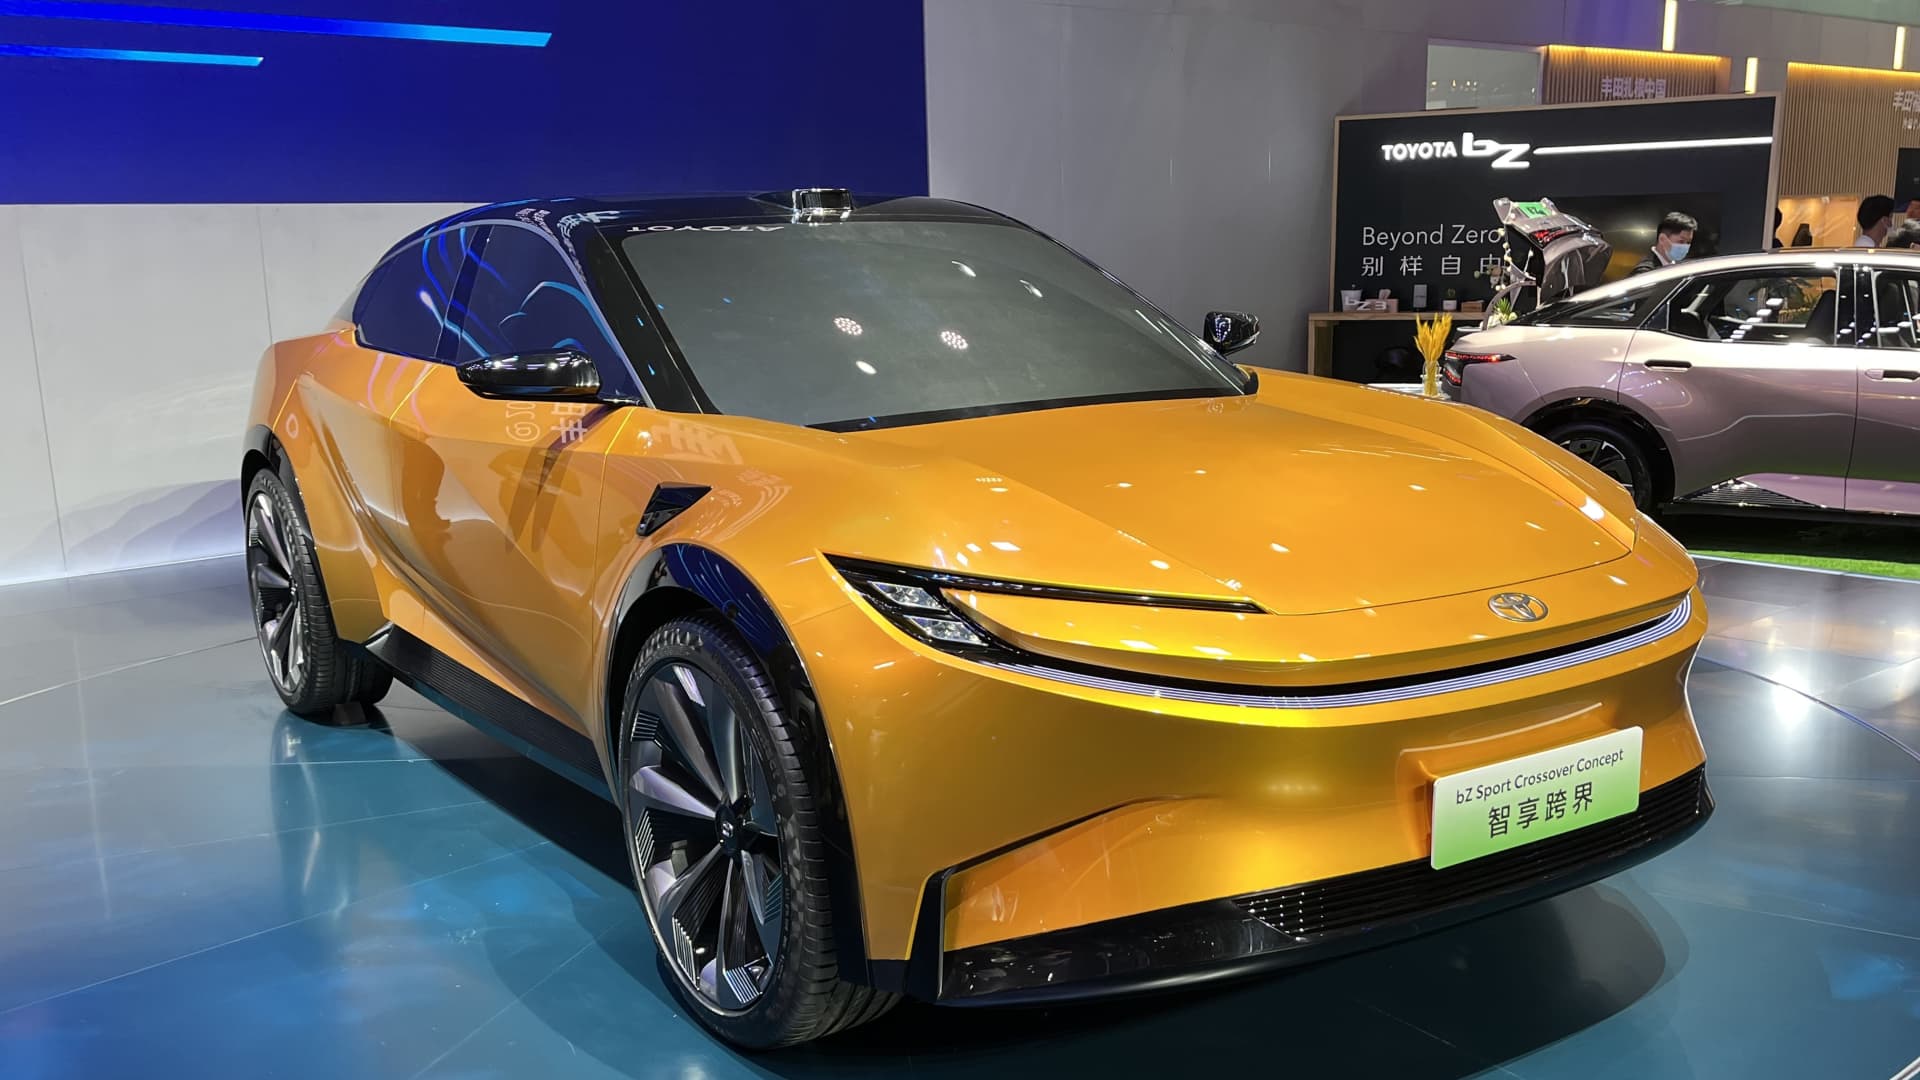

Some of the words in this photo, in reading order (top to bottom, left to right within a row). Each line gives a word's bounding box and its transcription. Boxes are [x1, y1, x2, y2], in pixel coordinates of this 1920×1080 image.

[1381, 141, 1457, 161] TOYOTA
[1362, 224, 1443, 250] Beyond
[1451, 224, 1501, 244] Zero
[1361, 254, 1502, 277] 别样自由
[1456, 787, 1473, 805] bZ
[1476, 778, 1511, 801] Sport
[1514, 763, 1575, 790] Crossover
[1576, 748, 1625, 773] Concept
[1488, 781, 1594, 839] 智享跨界
